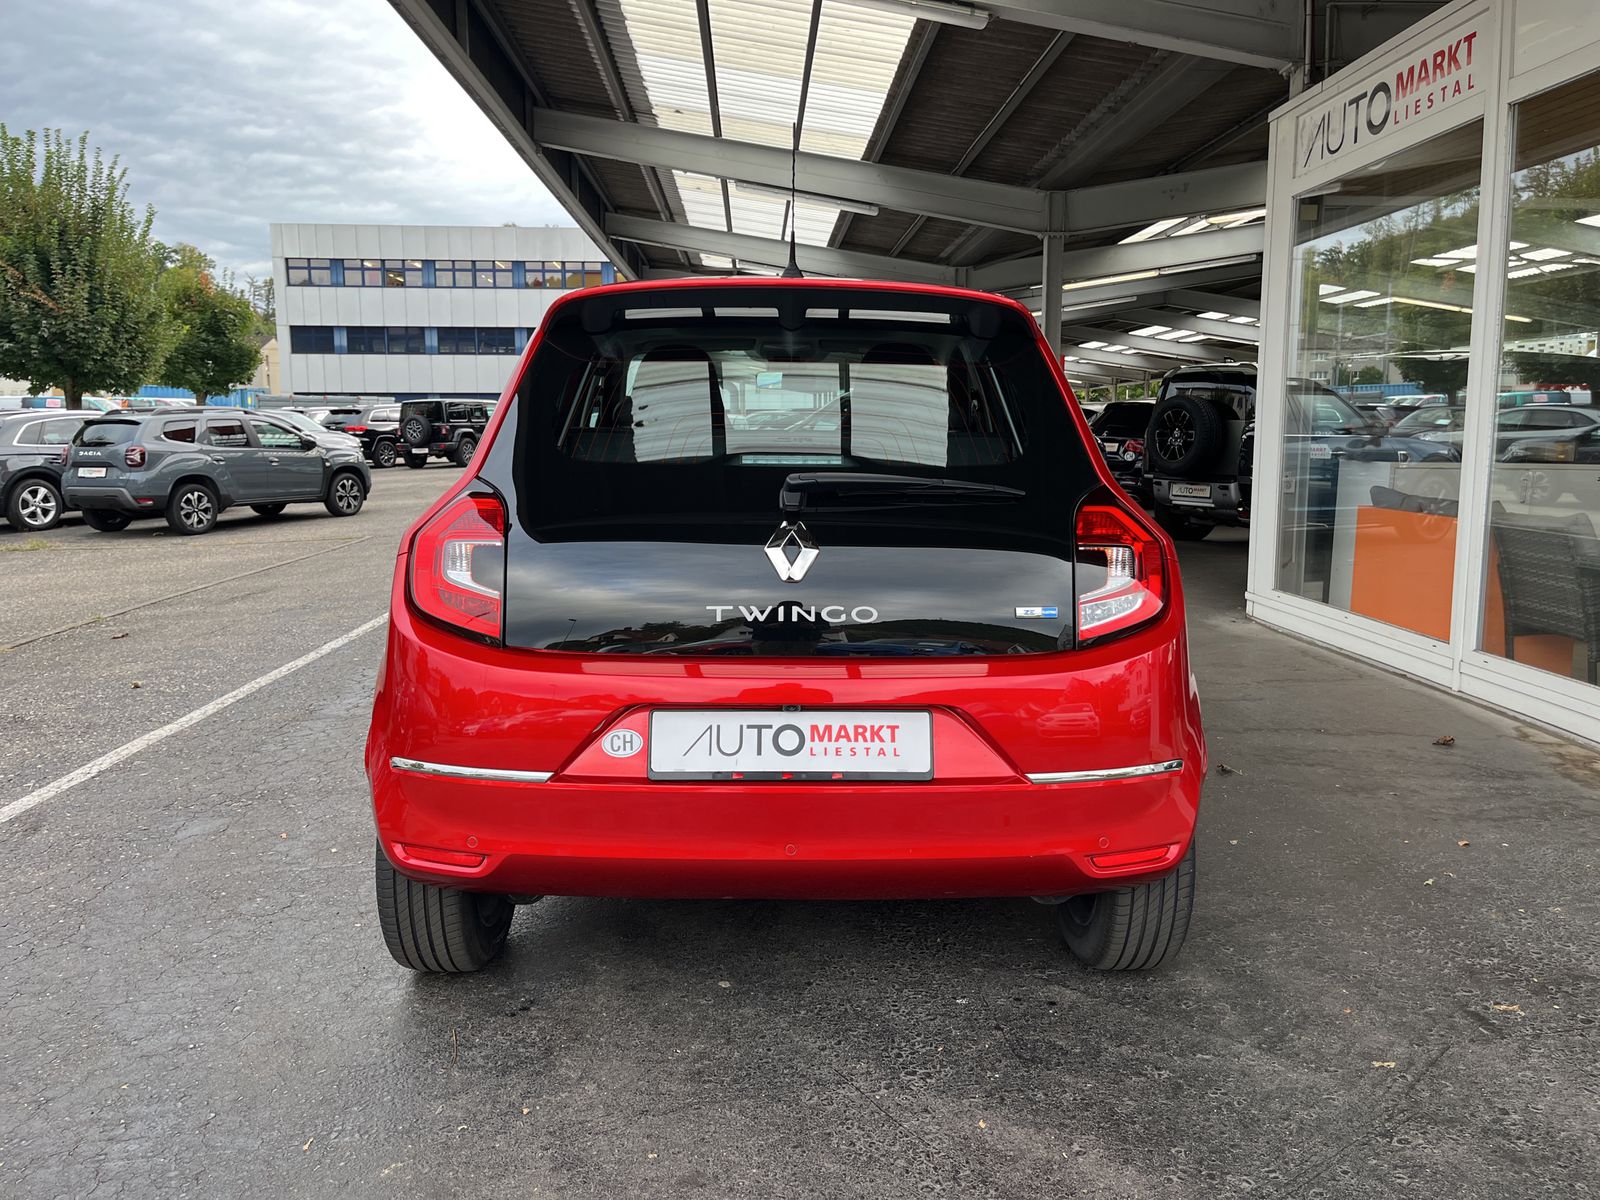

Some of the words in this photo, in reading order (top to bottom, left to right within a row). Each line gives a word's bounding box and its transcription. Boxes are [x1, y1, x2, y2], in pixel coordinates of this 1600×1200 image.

[1303, 81, 1392, 168] AUTO
[1395, 31, 1477, 102] MARKT
[1394, 74, 1474, 125] LIESTAL
[706, 605, 878, 623] TWINGO
[610, 734, 634, 752] CH
[682, 723, 806, 757] AUTO
[809, 724, 900, 743] MARKT
[809, 747, 900, 757] LIESTAL
